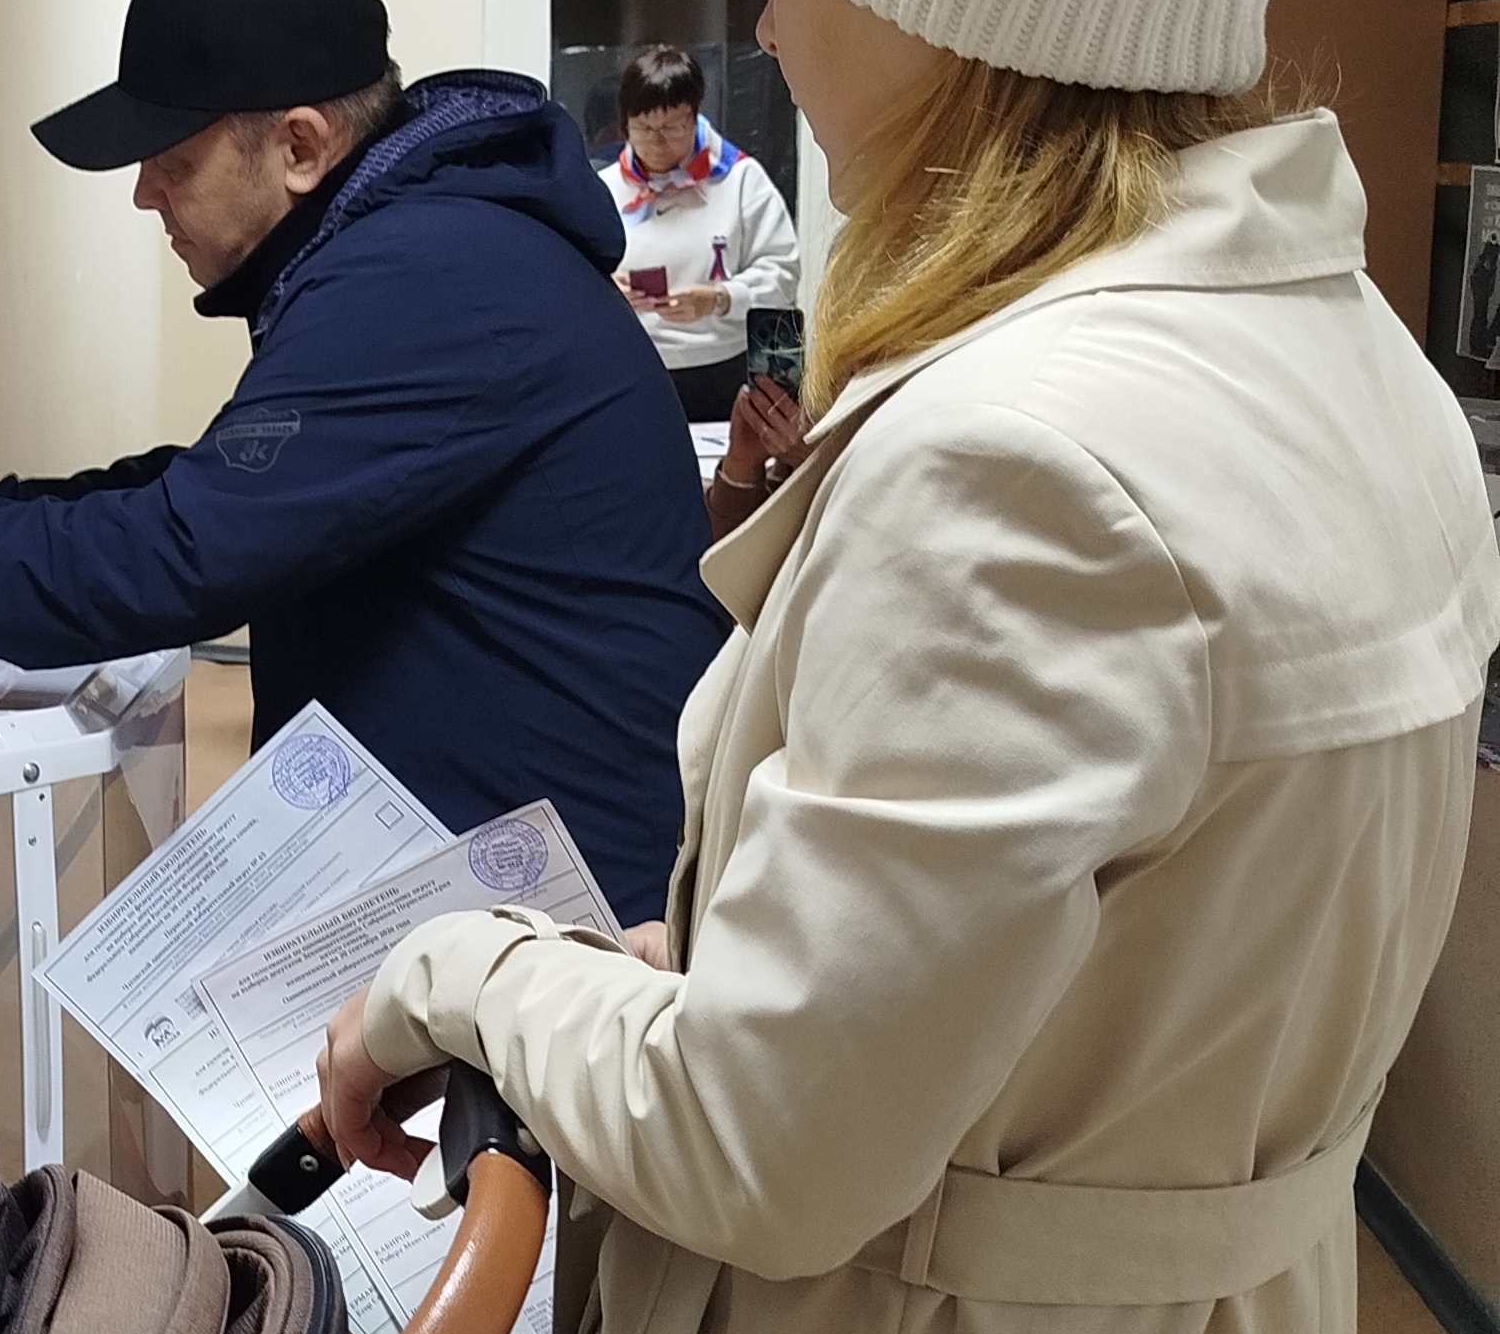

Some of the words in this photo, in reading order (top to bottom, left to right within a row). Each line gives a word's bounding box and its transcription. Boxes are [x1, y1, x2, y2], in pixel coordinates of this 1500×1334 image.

[96, 871, 161, 933] ИЗБИРАТЕЛЬНЫЙ
[158, 826, 207, 873] БЮЛЛЕТЕНЬ
[262, 916, 341, 961] ИЗБИРАТЕЛЬНЫЙ
[341, 885, 399, 920] БЮЛЛЕТЕНЬ
[337, 1172, 373, 1198] ЗАХАРОВ
[380, 1244, 403, 1265] Роберт
